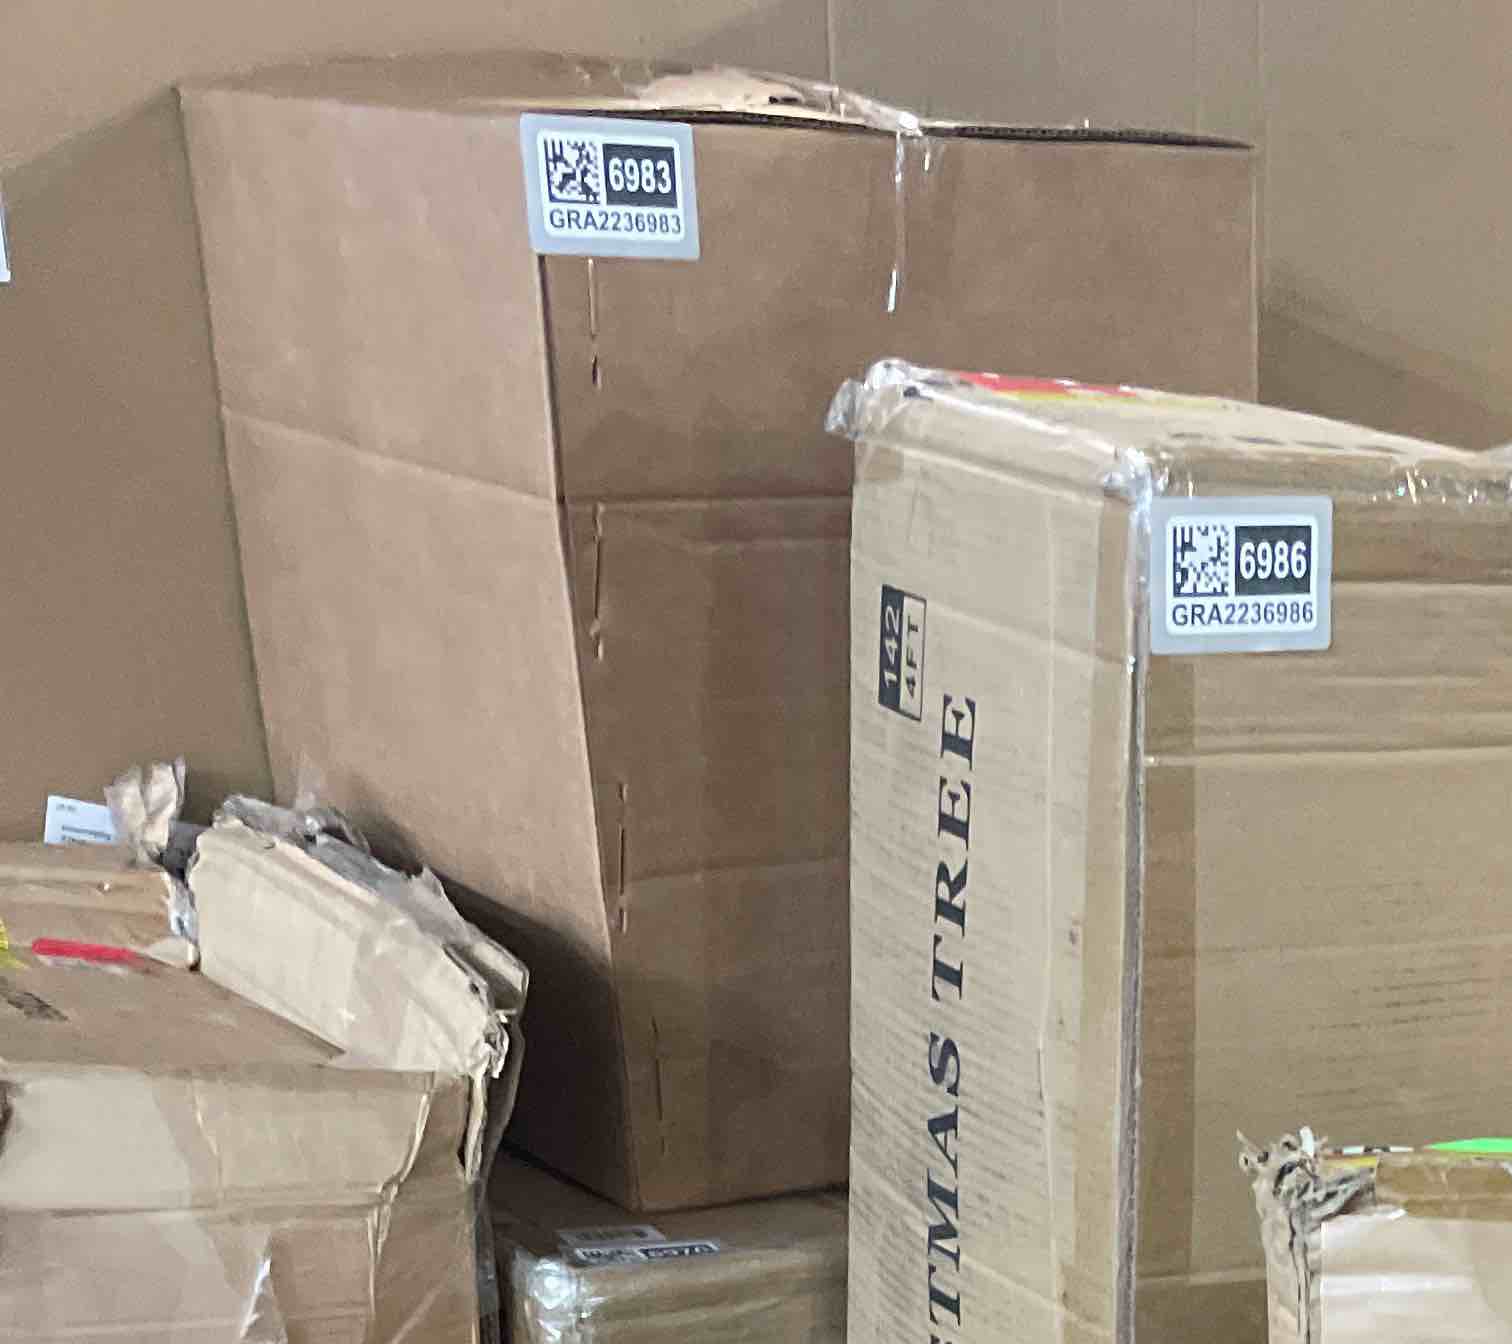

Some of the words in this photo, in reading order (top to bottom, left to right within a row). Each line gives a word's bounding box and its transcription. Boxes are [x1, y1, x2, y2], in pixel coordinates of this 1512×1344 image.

[608, 157, 672, 194] 6983
[549, 208, 681, 234] GRA2236983
[1239, 540, 1307, 580] 6986
[1172, 601, 1313, 626] GRA2236986
[884, 605, 900, 689] 142
[905, 615, 918, 699] 4FT
[931, 694, 976, 1002] TREE
